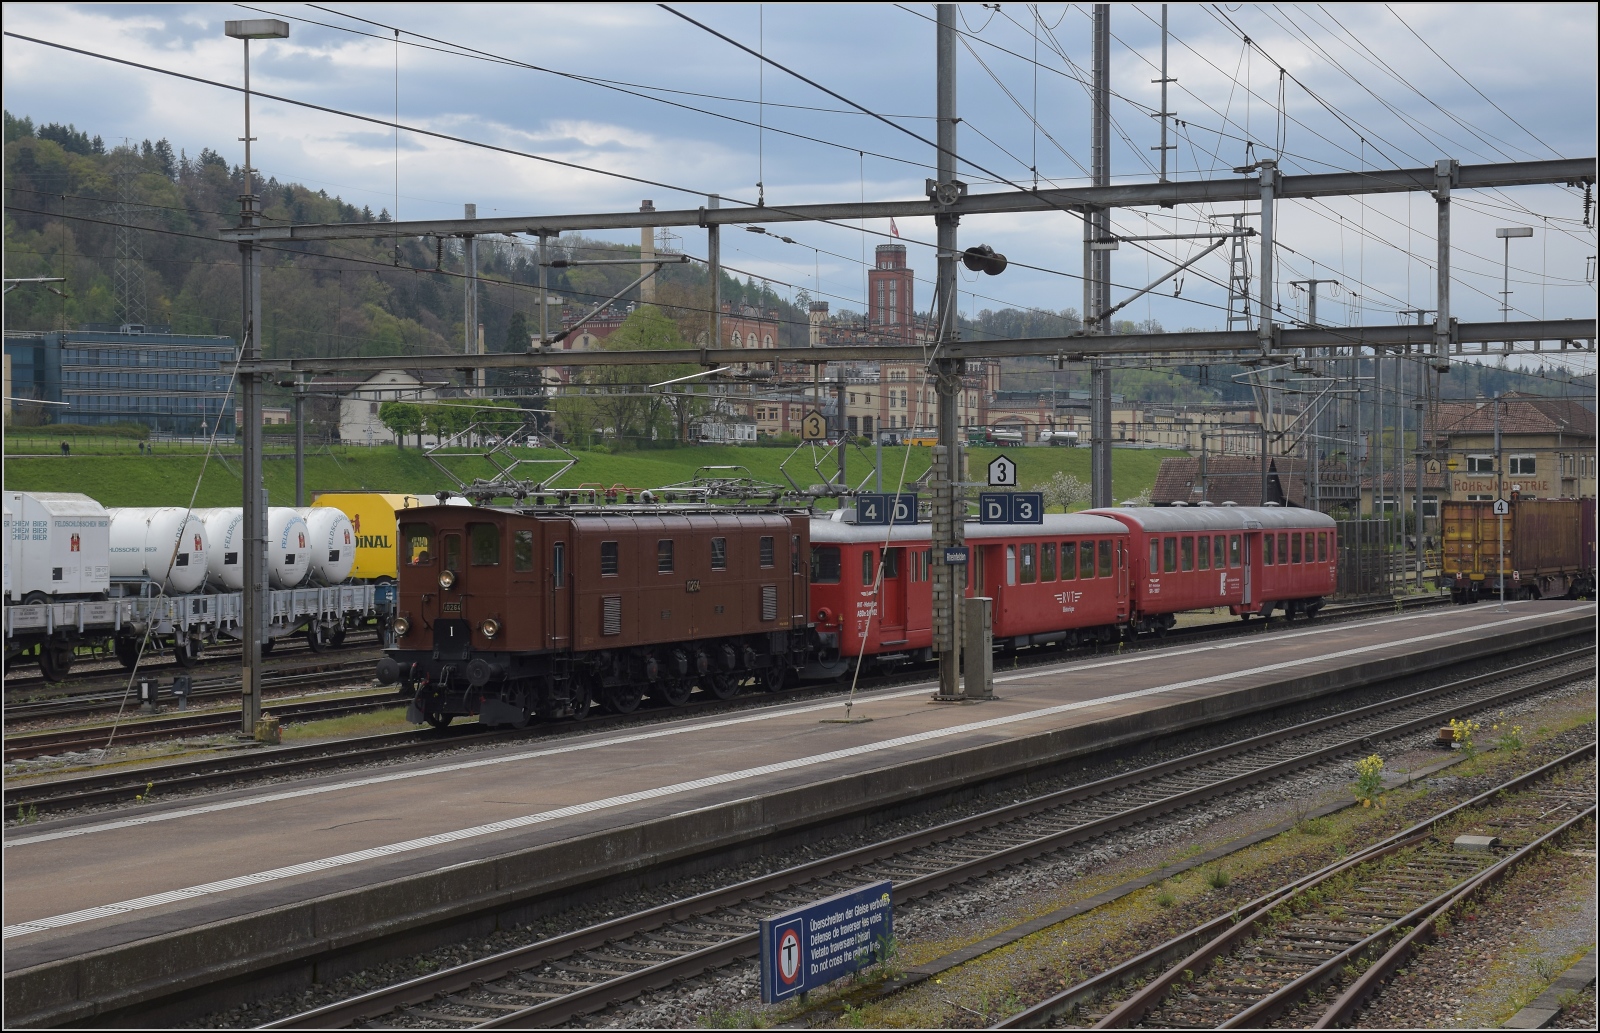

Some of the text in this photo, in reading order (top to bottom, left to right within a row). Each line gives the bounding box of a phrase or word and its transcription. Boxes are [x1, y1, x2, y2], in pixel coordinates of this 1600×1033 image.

[808, 417, 821, 437] 3
[996, 462, 1007, 483] 3
[1429, 461, 1437, 473] 4
[865, 504, 877, 520] 4
[895, 503, 909, 519] D
[988, 502, 1002, 519] D
[1019, 502, 1033, 519] 3
[1496, 501, 1504, 513] 4
[810, 911, 845, 932] Überschreiten
[845, 908, 854, 920] der
[854, 903, 869, 917] Gleise
[810, 912, 882, 947] Défense de traverser les voies
[810, 944, 830, 960] Vietato
[830, 937, 854, 954] traversare
[810, 963, 819, 975] Do
[819, 958, 829, 972] not
[828, 954, 843, 968] cross
[843, 950, 852, 962] the
